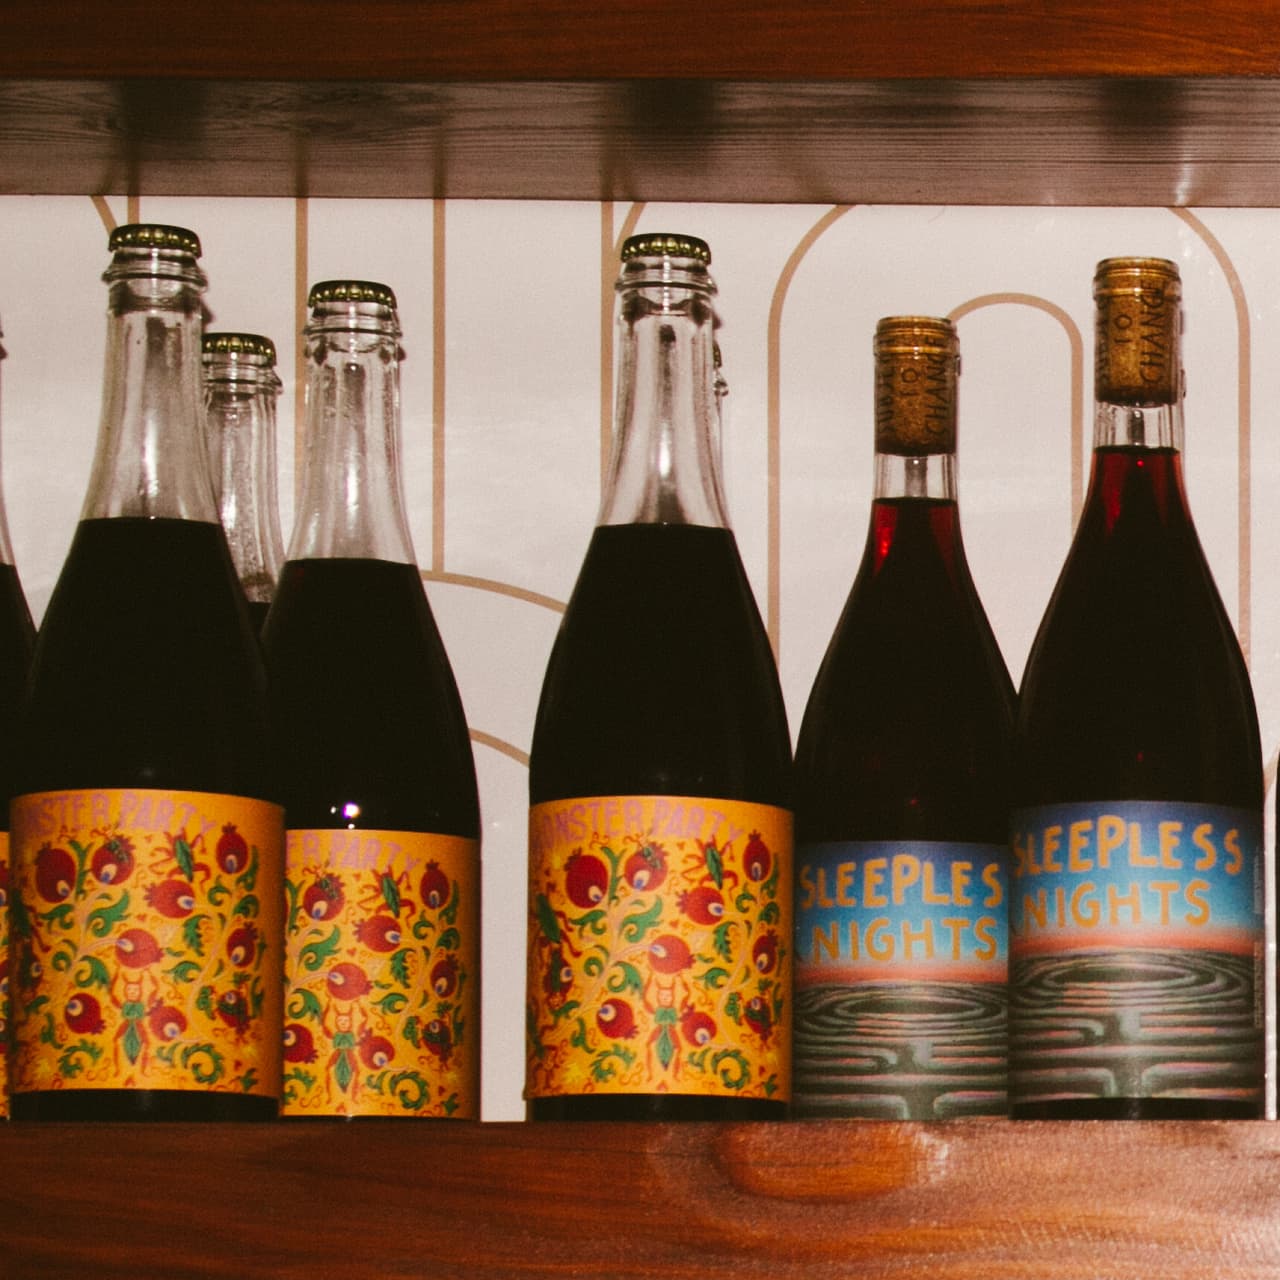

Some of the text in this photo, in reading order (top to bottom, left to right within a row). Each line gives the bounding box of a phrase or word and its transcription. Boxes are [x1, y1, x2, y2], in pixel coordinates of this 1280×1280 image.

[1012, 815, 1244, 878] SLEEPLESS
[801, 854, 1004, 911] SLEEPLES
[1023, 879, 1212, 936] NIGHTS
[813, 916, 998, 966] NIGHTS
